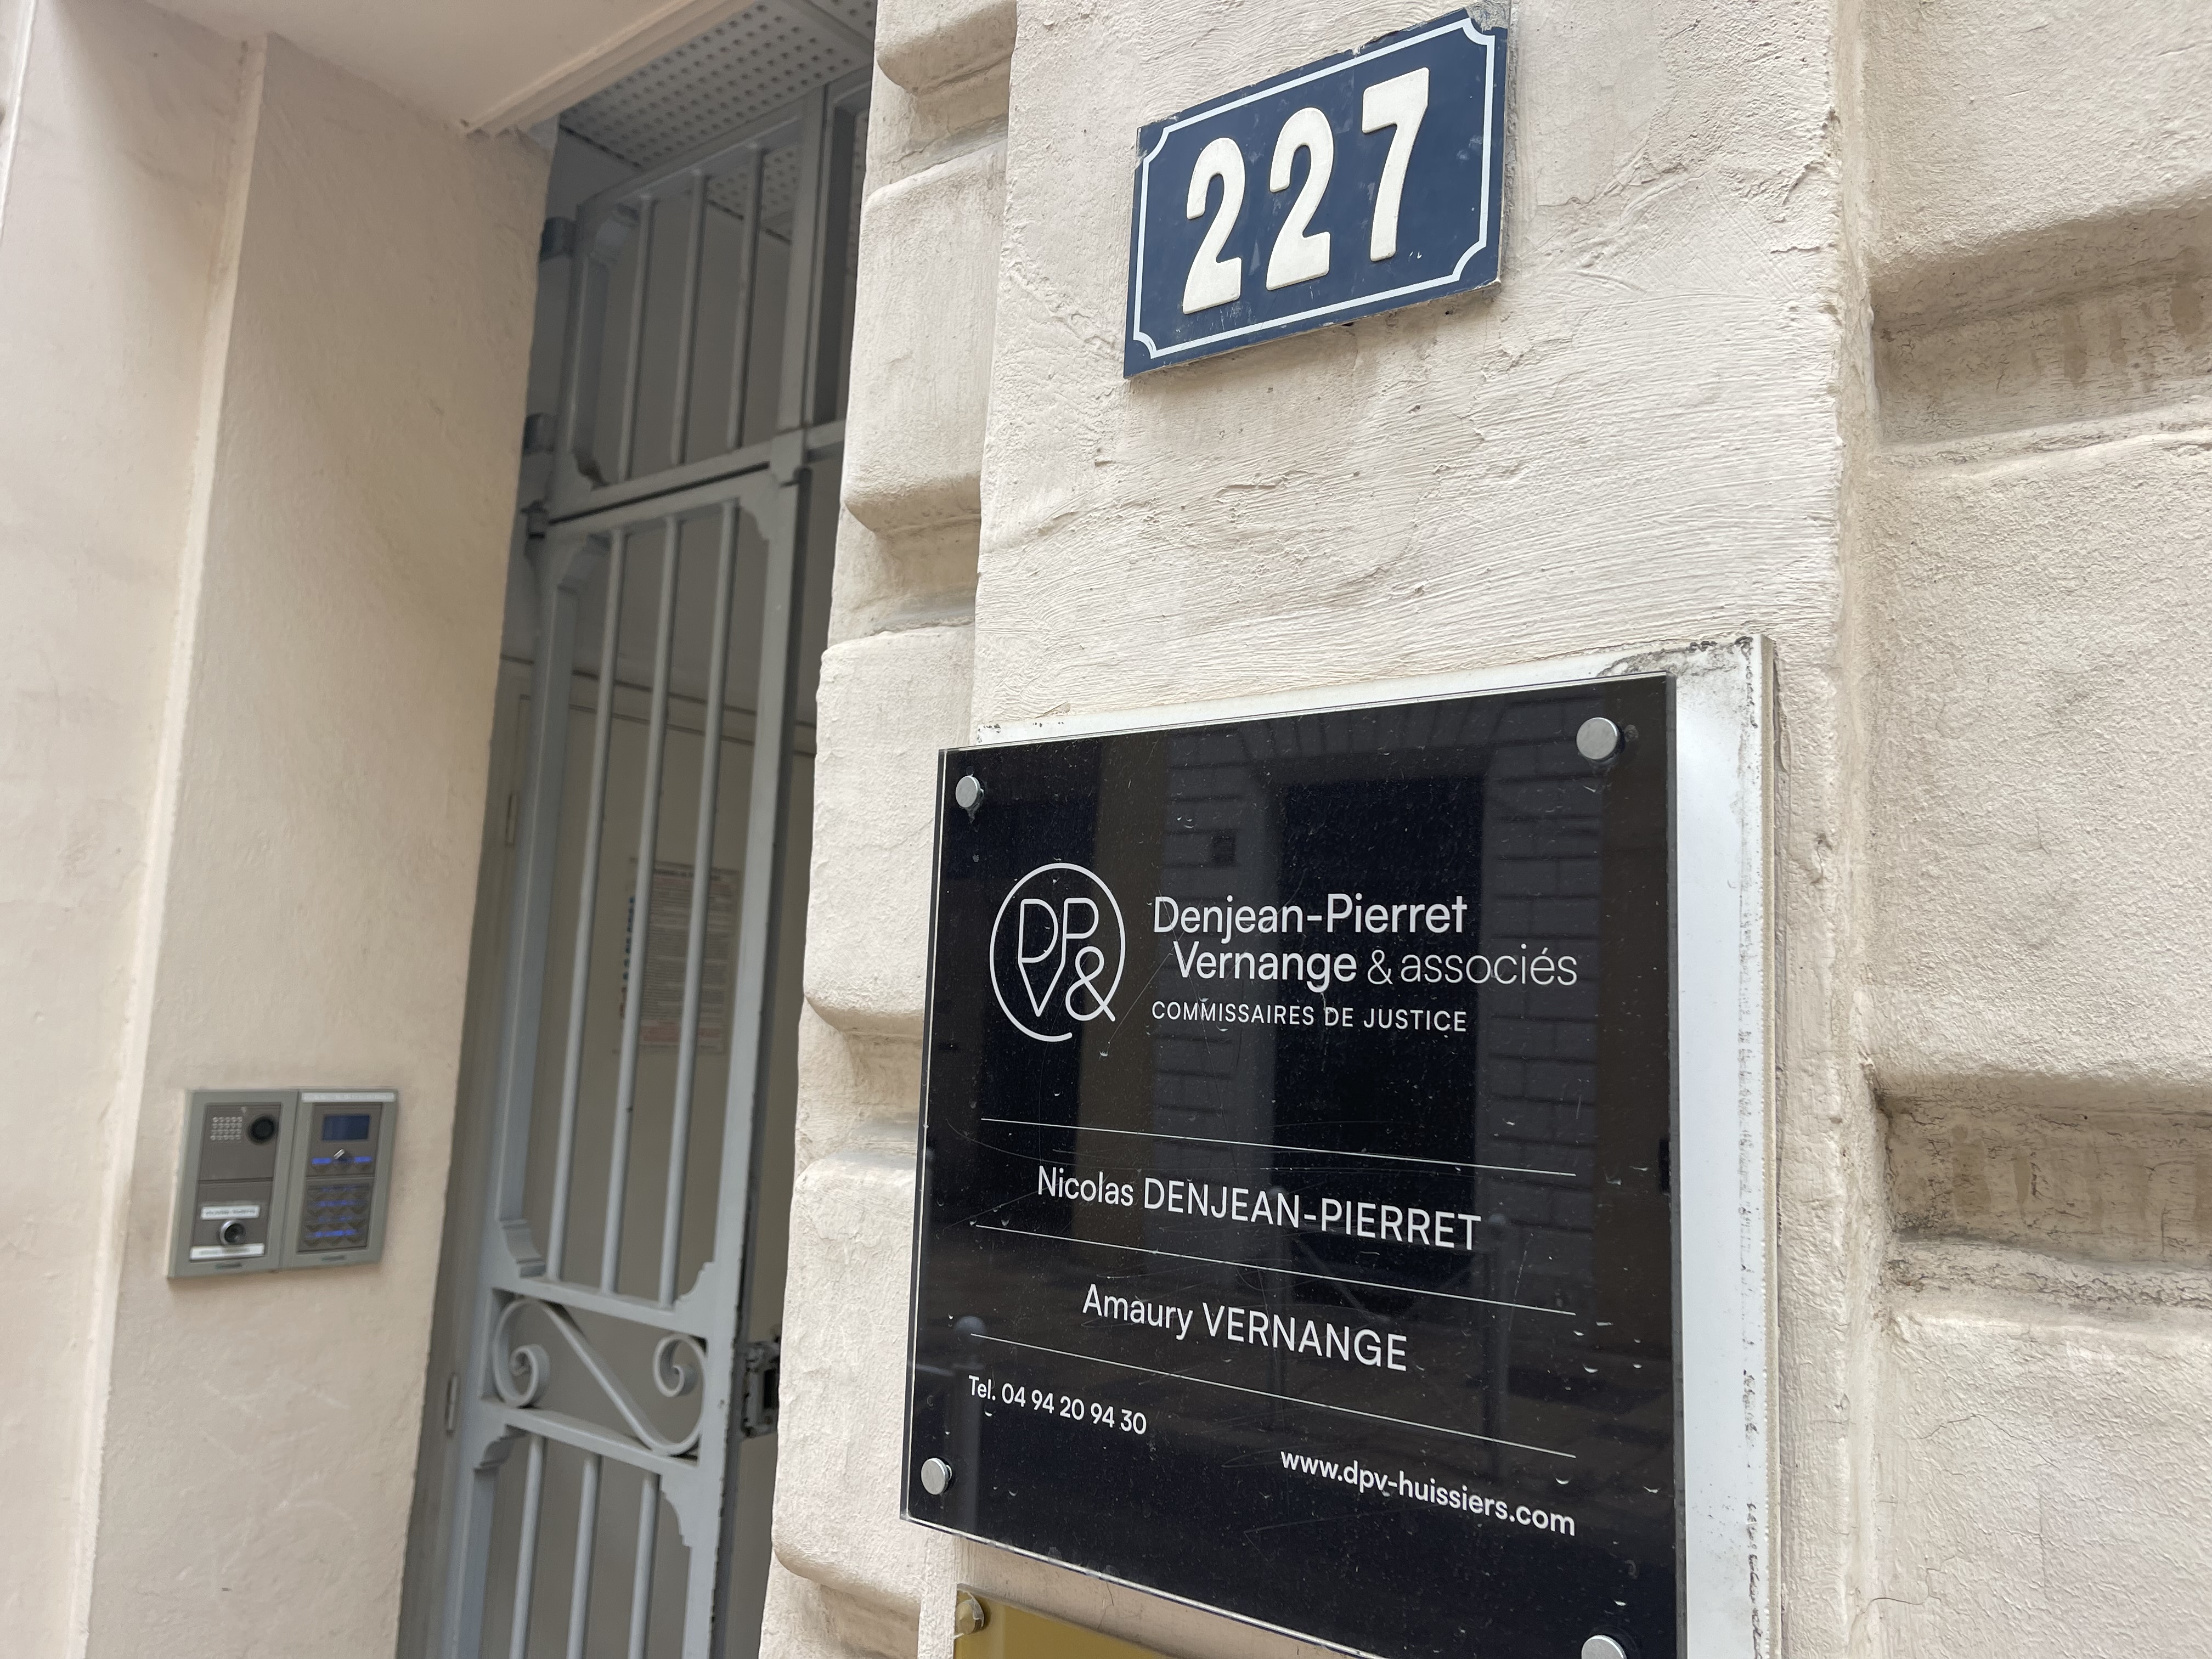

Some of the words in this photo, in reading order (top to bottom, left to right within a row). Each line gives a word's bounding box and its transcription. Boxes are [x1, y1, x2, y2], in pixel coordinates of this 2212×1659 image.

[1182, 67, 1429, 314] 227
[1154, 893, 1468, 944] Denjean-Pierret
[1173, 941, 1357, 993] Vernange
[1367, 949, 1393, 985] &
[1401, 943, 1577, 986] associés
[1152, 1001, 1314, 1025] COMMISSAIRES
[1324, 1007, 1353, 1027] DE
[1364, 1008, 1466, 1032] JUSTICE
[1038, 1165, 1133, 1206] Nicolas
[1144, 1177, 1482, 1250] DENJEAN-PIERRET
[1082, 1283, 1193, 1340] Amaury
[1202, 1302, 1407, 1372] VERNANGE
[968, 1375, 996, 1401] Tel.
[1002, 1383, 1026, 1407] 04
[1031, 1389, 1054, 1414] 94
[1059, 1396, 1085, 1420] 20
[1090, 1402, 1115, 1428] 94
[1120, 1409, 1147, 1435] 30
[1280, 1451, 1575, 1537] www.dpv-huissiers.com
